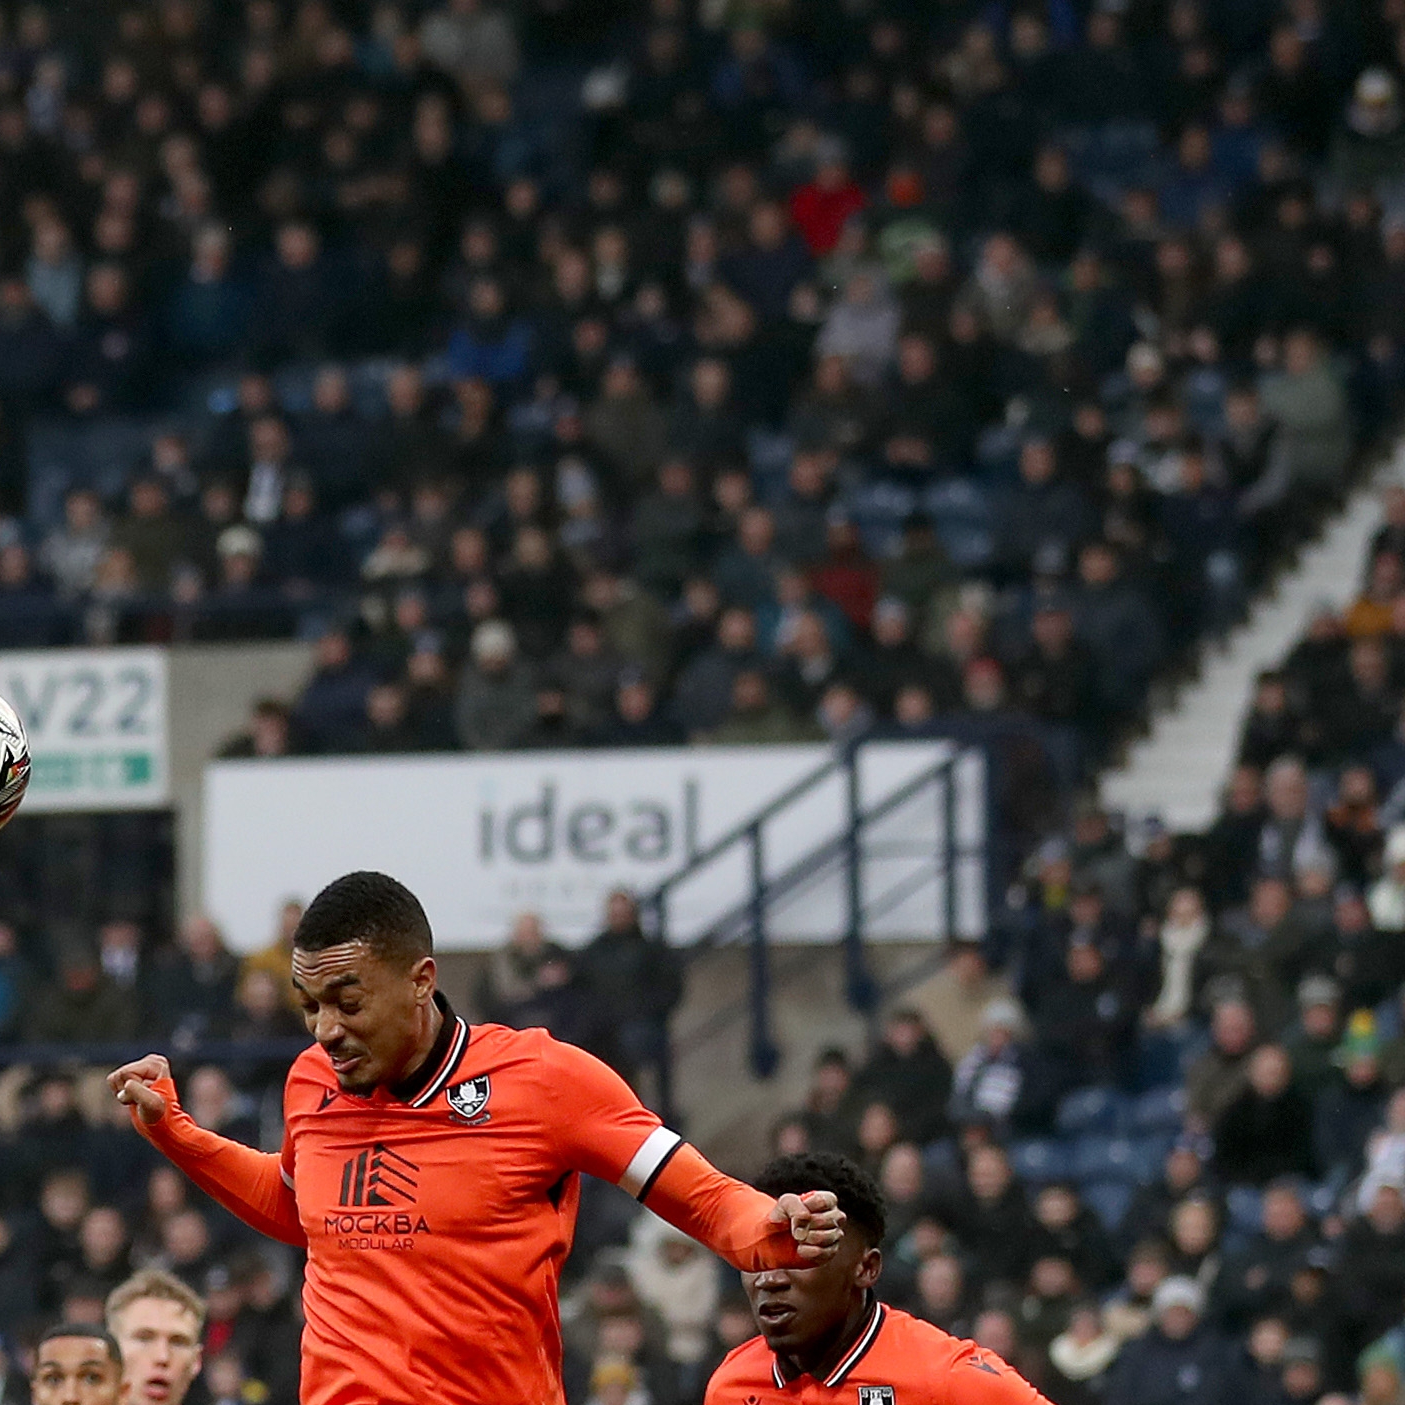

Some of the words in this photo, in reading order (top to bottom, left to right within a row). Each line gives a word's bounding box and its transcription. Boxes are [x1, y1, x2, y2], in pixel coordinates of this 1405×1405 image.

[5, 667, 152, 737] V22
[479, 775, 699, 864] ideal
[323, 1215, 431, 1235] MOCKBA
[338, 1237, 415, 1251] MODULAR
